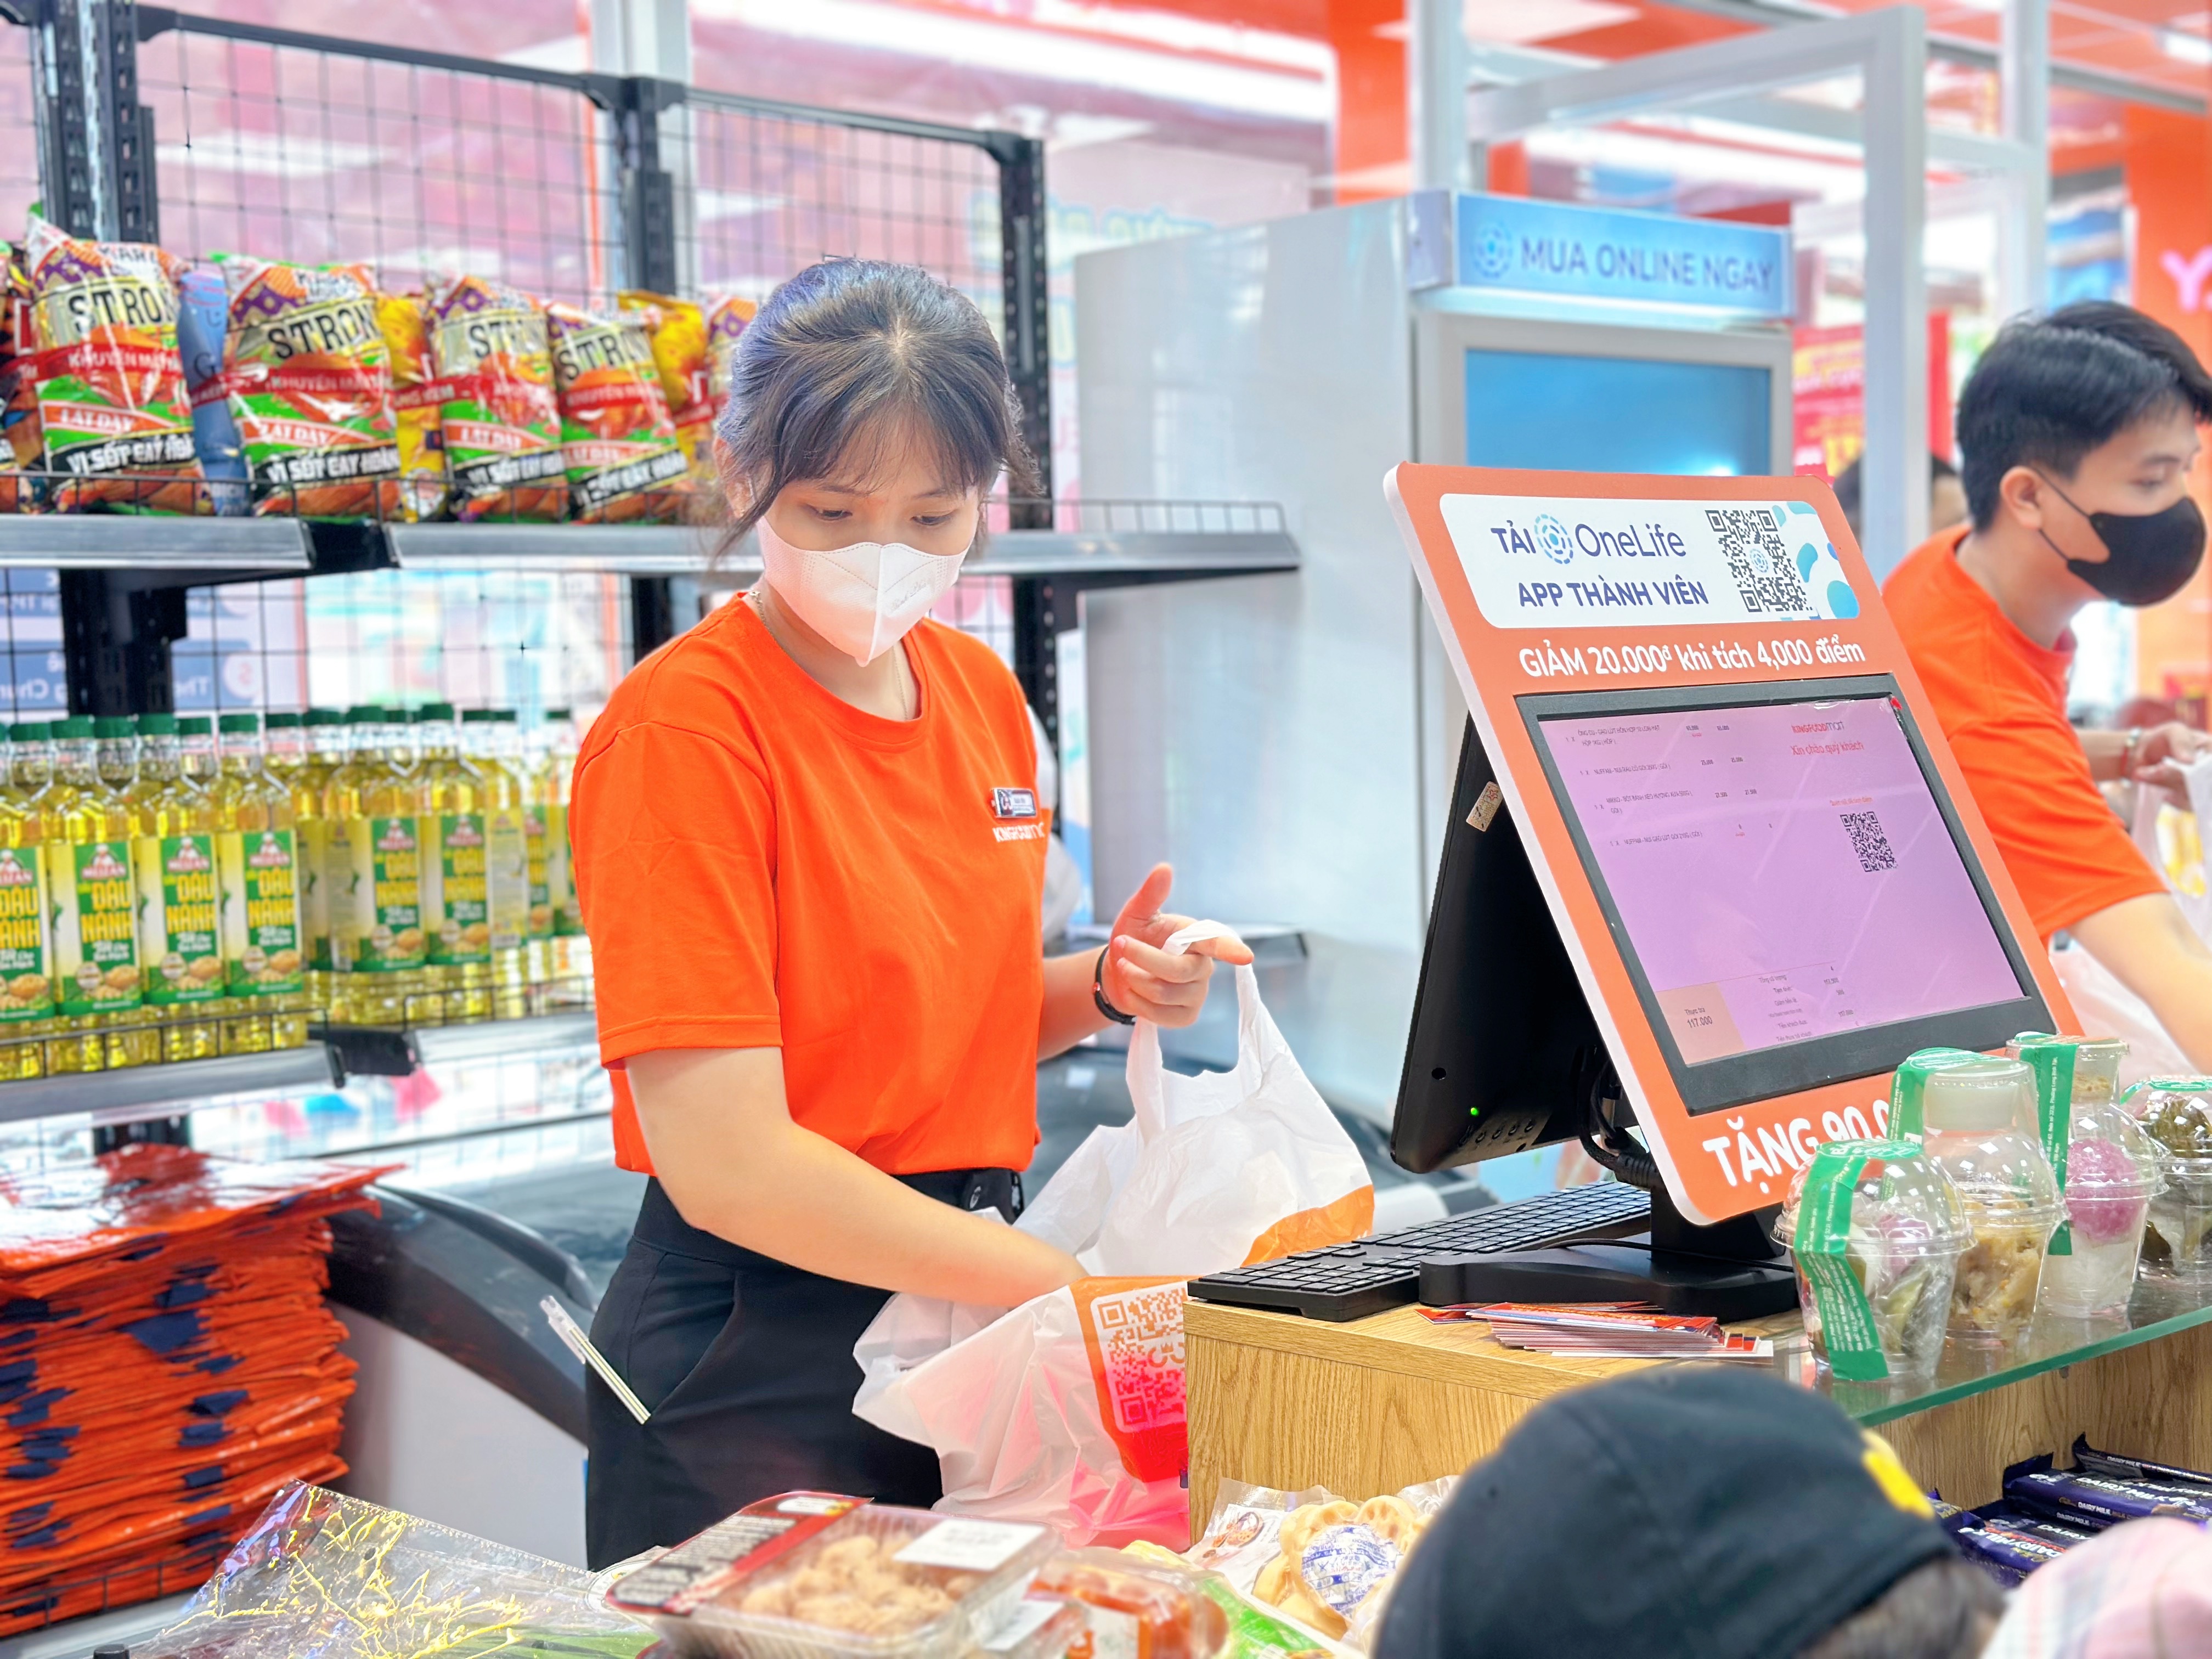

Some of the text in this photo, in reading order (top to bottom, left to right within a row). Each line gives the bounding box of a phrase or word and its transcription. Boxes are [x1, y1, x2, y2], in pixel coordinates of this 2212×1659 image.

[1520, 236, 1774, 292] MUA ONLINE NGAY
[1490, 519, 1687, 558] TẢI OneLife
[1519, 572, 1710, 608] APP THÀNH VIÊN
[1519, 638, 1587, 678] GIẢM
[1679, 642, 1713, 672] khi
[1713, 640, 1755, 670] tích
[1757, 637, 1813, 670] 4,000
[1815, 633, 1866, 664] điểm
[1686, 1015, 1713, 1029] 117.000
[1702, 1114, 1820, 1195] TẶNG
[2076, 1476, 2131, 1492] DAIRY
[2126, 1488, 2170, 1501] MILK
[2057, 1511, 2075, 1522] DAIRY
[2078, 1501, 2111, 1515] DAIRY MILK
